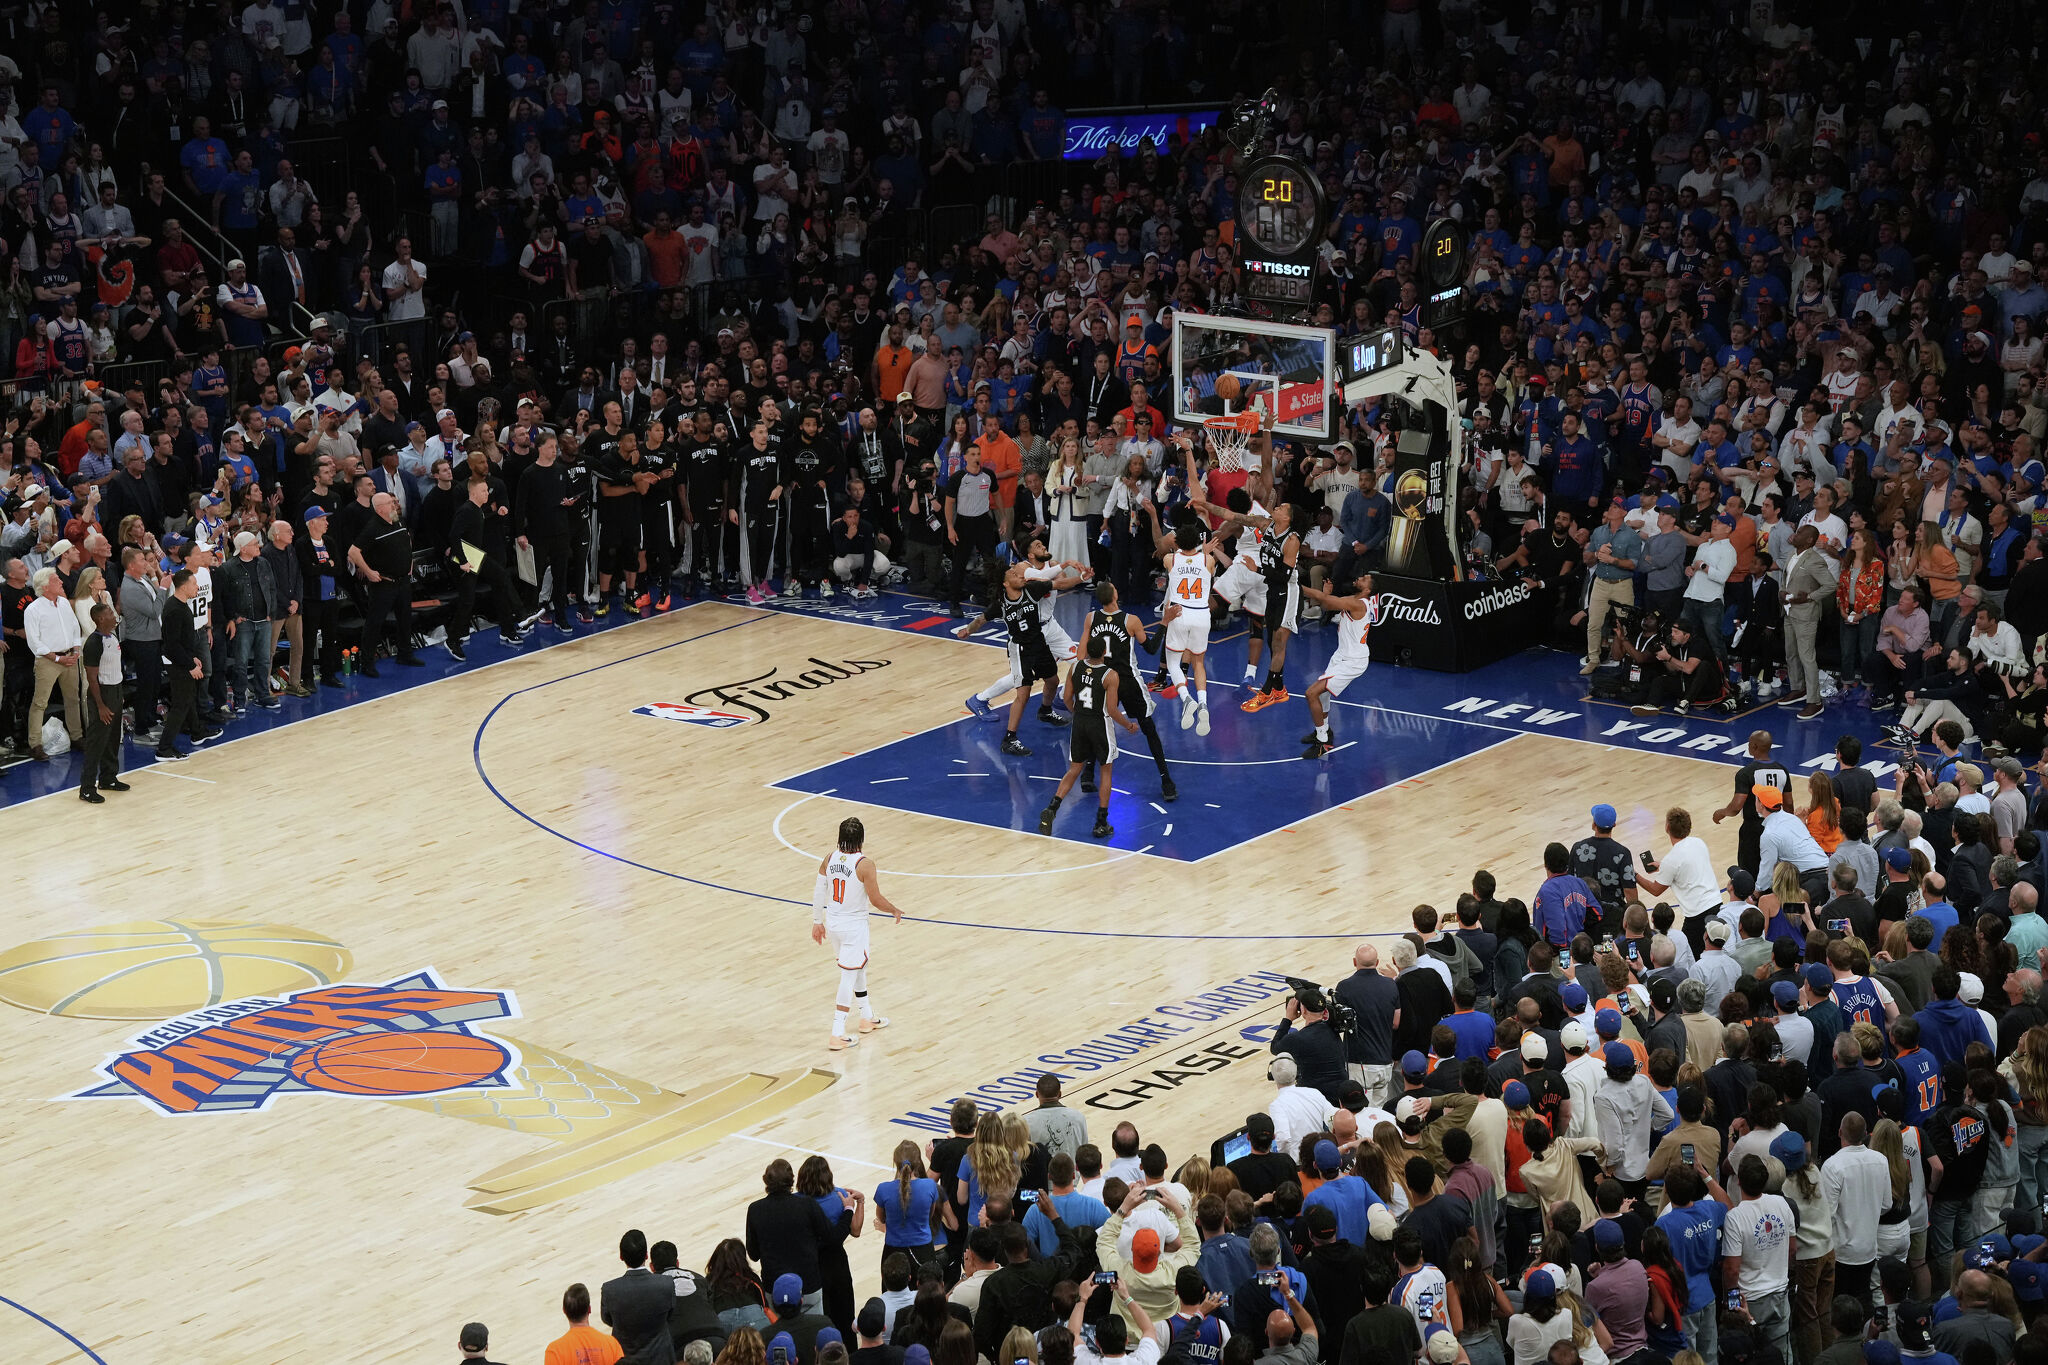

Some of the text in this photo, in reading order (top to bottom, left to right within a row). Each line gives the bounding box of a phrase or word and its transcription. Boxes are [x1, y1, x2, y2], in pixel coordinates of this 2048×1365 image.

[1063, 122, 1168, 155] Michelob
[1263, 179, 1291, 202] 2.0
[1437, 238, 1452, 256] 2.0
[1262, 261, 1310, 277] TISSOT
[1439, 287, 1461, 301] TISSOT
[65, 343, 83, 358] 32
[1360, 344, 1376, 371] App
[314, 369, 326, 385] 3
[4, 384, 16, 394] 106
[1301, 391, 1322, 408] State
[1626, 409, 1641, 426] 19
[750, 454, 777, 468] SPURS
[1430, 460, 1442, 479] GET
[1327, 483, 1357, 494] NEW YOR
[1430, 478, 1441, 495] THE
[1431, 496, 1443, 515] App
[1261, 552, 1276, 569] 24
[1177, 578, 1203, 600] 44
[192, 597, 207, 617] 12
[1371, 592, 1442, 627] Finals
[1464, 582, 1531, 620] coinbase
[1006, 604, 1035, 621] SPURS
[1018, 619, 1029, 632] 5
[1102, 636, 1112, 658] 1
[1081, 674, 1094, 685] FOX
[684, 658, 892, 725] Finals
[1078, 686, 1093, 708] 4
[1443, 696, 1784, 759] NEW YORK
[1766, 773, 1777, 787] 61
[832, 878, 846, 904] 11
[1843, 993, 1877, 1013] BRUNSON
[136, 995, 285, 1050] NEW YORK
[1064, 1017, 1179, 1072] SQUARE
[1155, 971, 1291, 1032] GARDEN
[1853, 1008, 1871, 1023] 11
[113, 986, 507, 1112] KNICKS
[1085, 1041, 1263, 1110] CHASE
[1918, 1061, 1930, 1074] LIN
[1917, 1074, 1938, 1111] 17
[1693, 1219, 1713, 1233] MSC
[1190, 1342, 1220, 1361] DOLPH
